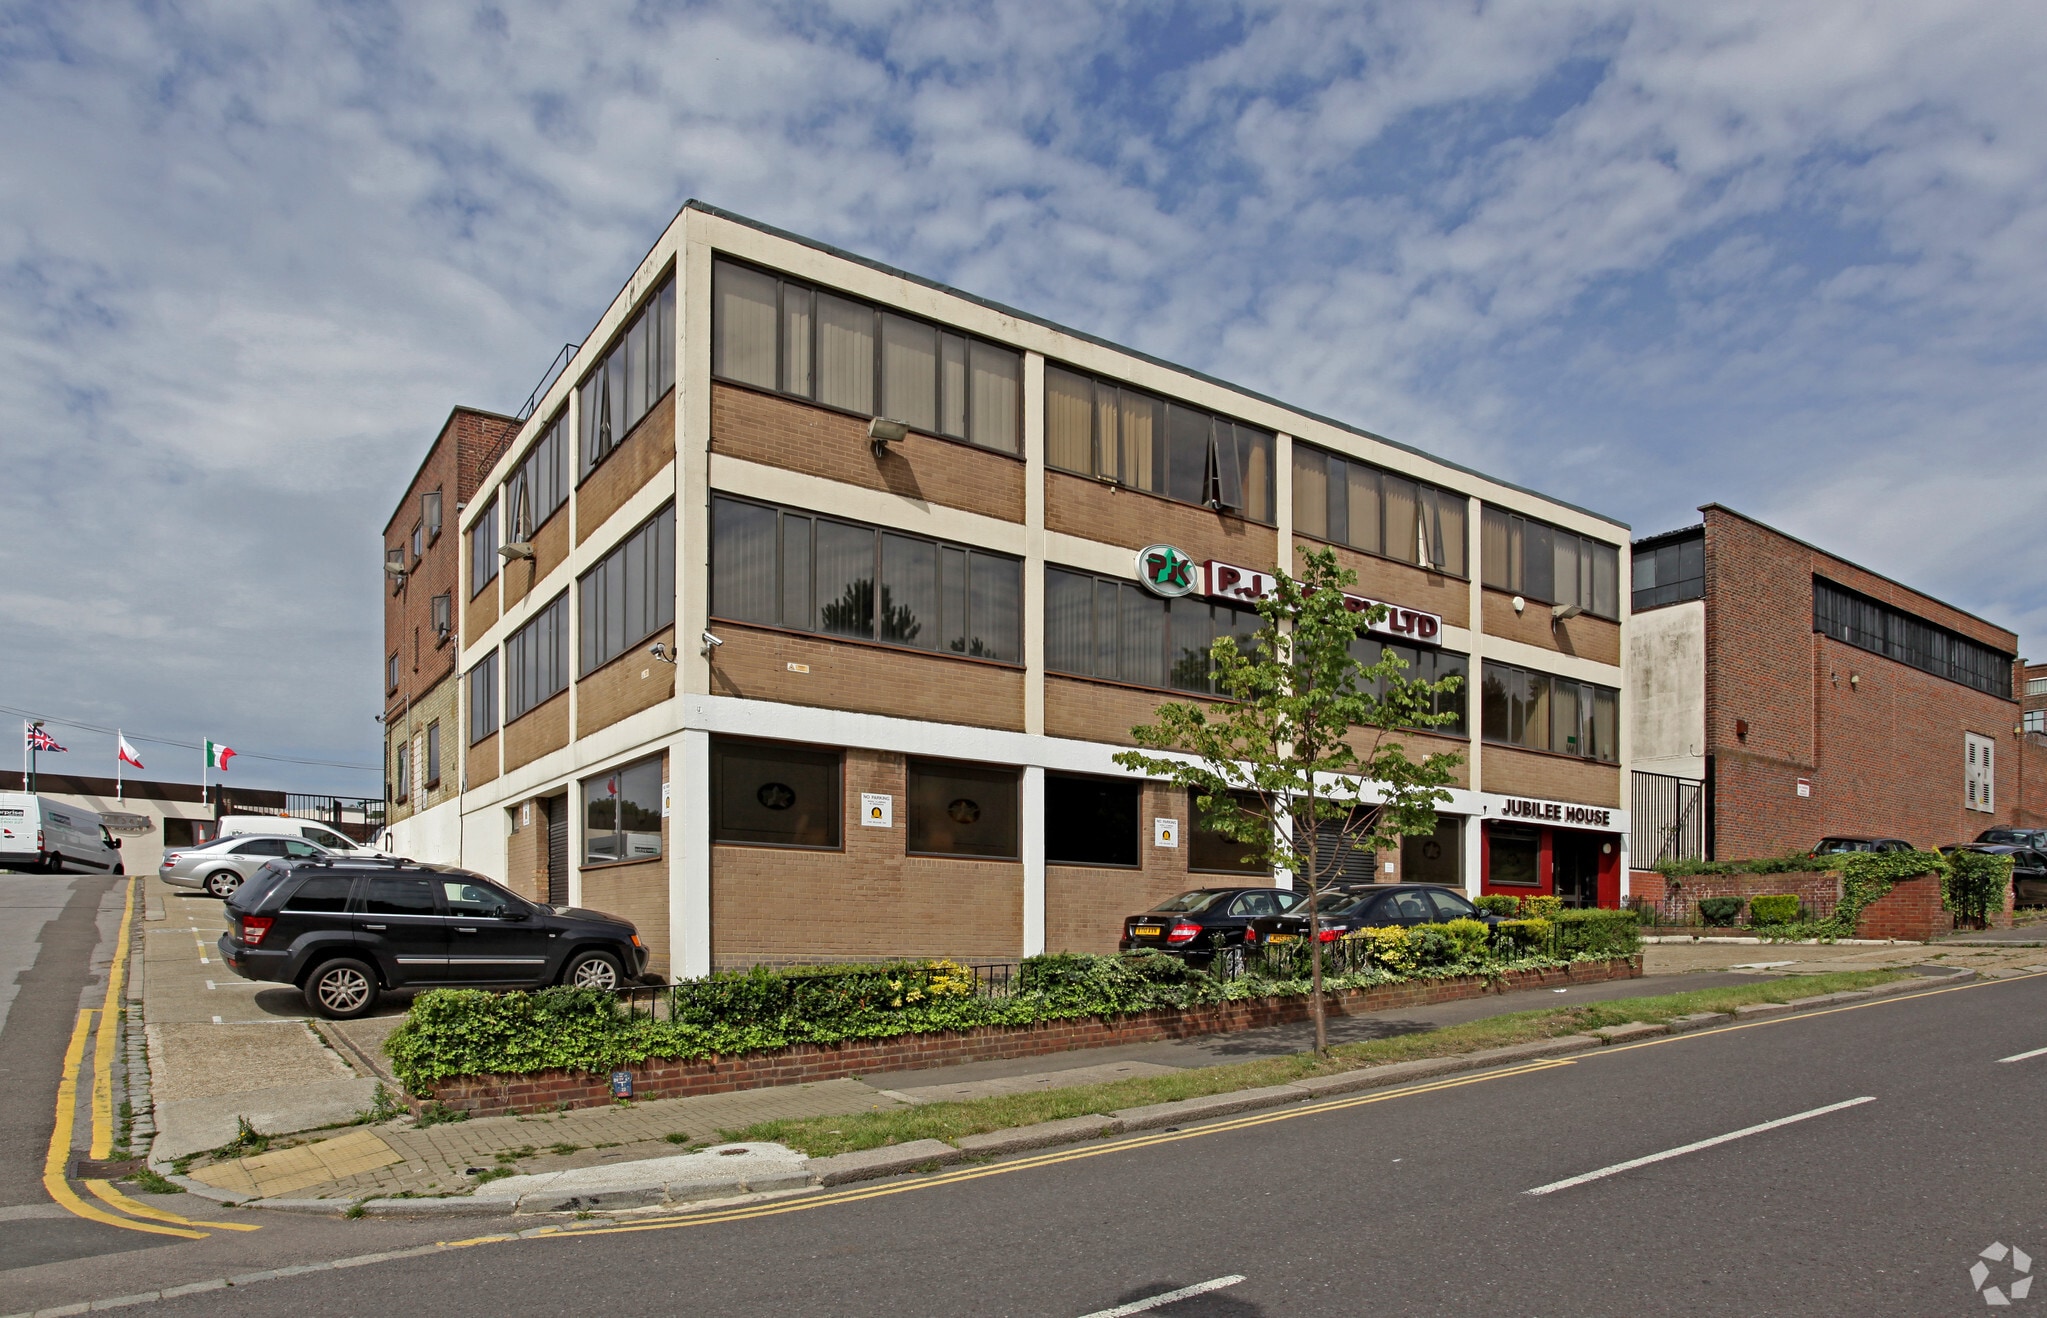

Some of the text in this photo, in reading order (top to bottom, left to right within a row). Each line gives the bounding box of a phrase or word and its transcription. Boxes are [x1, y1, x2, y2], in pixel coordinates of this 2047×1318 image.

[1218, 566, 1438, 637] P.J. LTD
[1502, 799, 1610, 825] JUBILEE HOUSE
